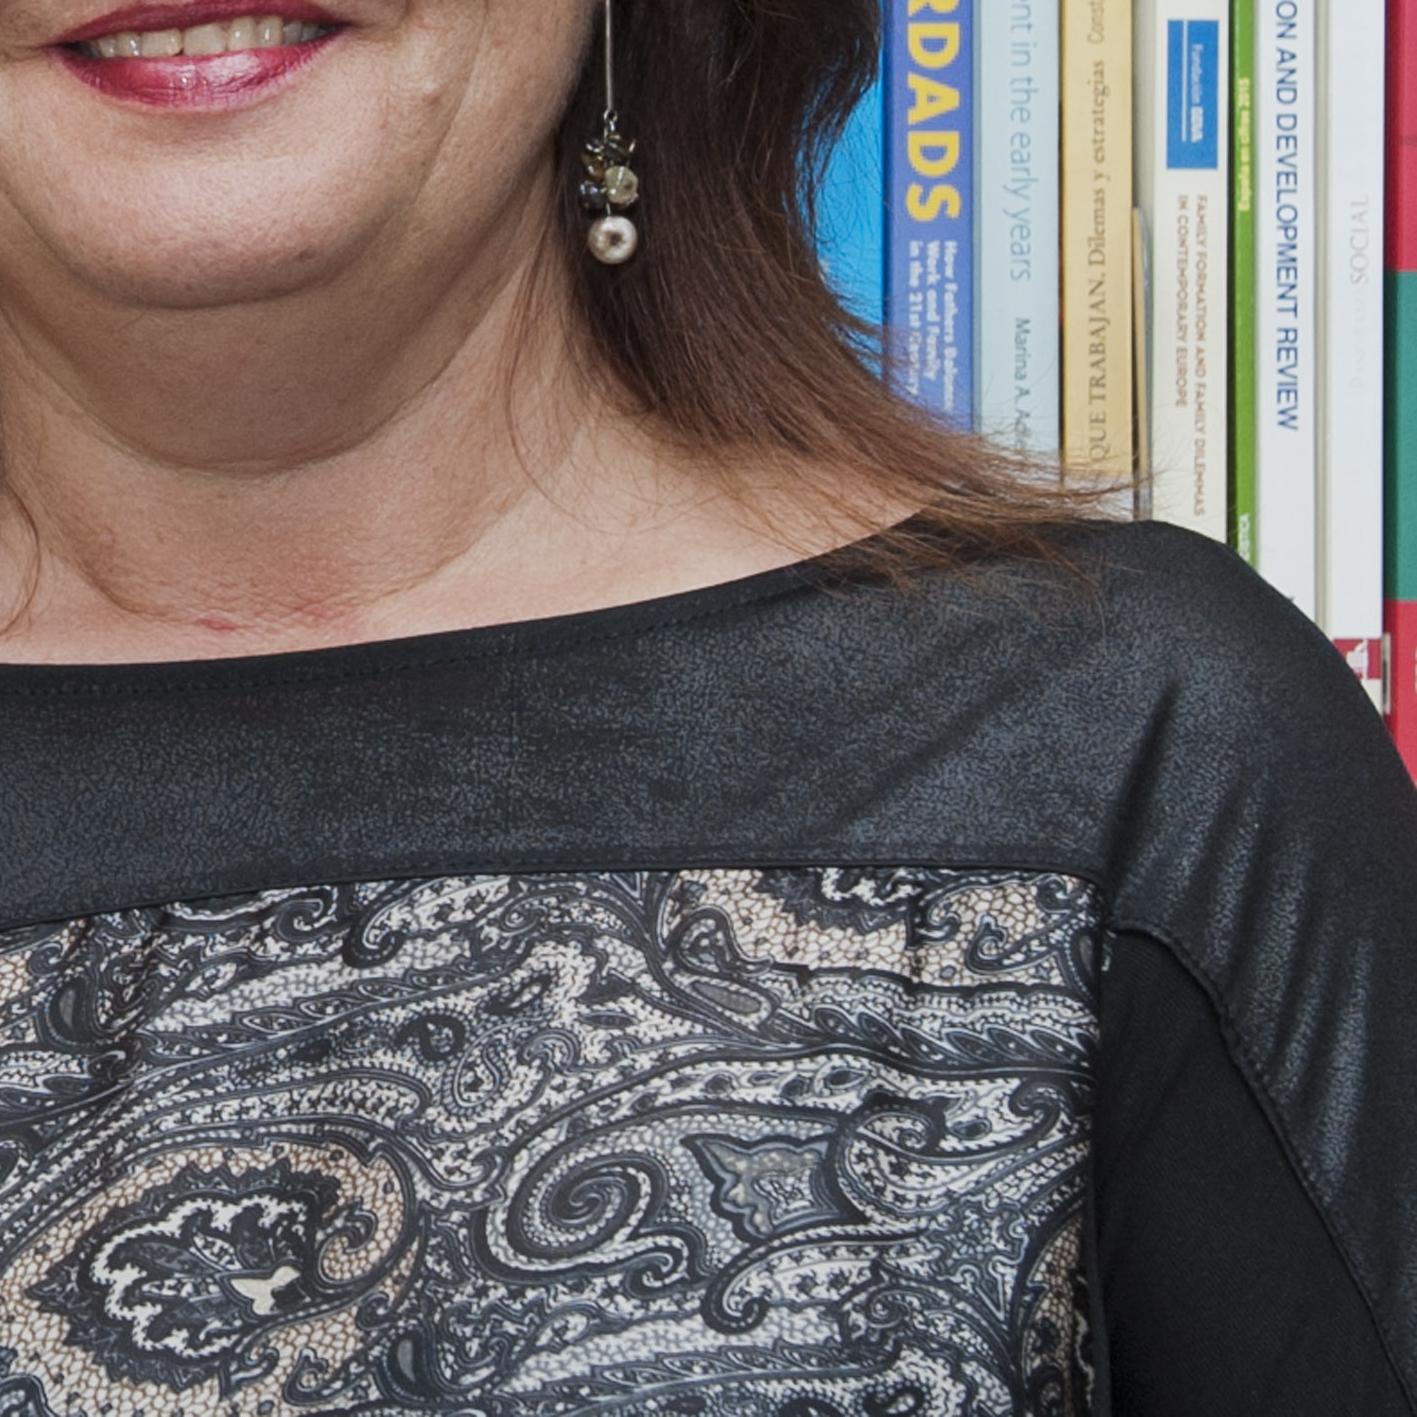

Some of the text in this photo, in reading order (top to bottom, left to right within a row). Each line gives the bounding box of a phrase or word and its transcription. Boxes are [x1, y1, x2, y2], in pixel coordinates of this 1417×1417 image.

[1010, 40, 1037, 68] in
[1275, 48, 1298, 106] AND
[1010, 77, 1038, 123] the
[1089, 60, 1111, 164] estrategias
[1003, 132, 1039, 201] early
[1092, 170, 1112, 182] y
[1003, 207, 1032, 281] years
[1086, 188, 1106, 266] Dilemas
[1195, 194, 1208, 247] FAMILY
[1275, 113, 1299, 319] DEVELOPMENT
[908, 240, 922, 256] in
[908, 260, 922, 288] the
[944, 240, 958, 276] How
[922, 240, 940, 380] Work and Family
[944, 282, 958, 344] Fathers
[1175, 194, 1188, 408] IN CONTEMPORARY EUROPE
[1195, 251, 1208, 342] FORMATION
[1013, 319, 1032, 382] Marina
[1087, 273, 1111, 405] TRABAJAN.
[1195, 346, 1207, 378] AND
[1013, 386, 1032, 404] A.
[1194, 381, 1207, 436] FAMILY
[1276, 326, 1299, 431] REVIEW
[1087, 412, 1111, 464] QUE
